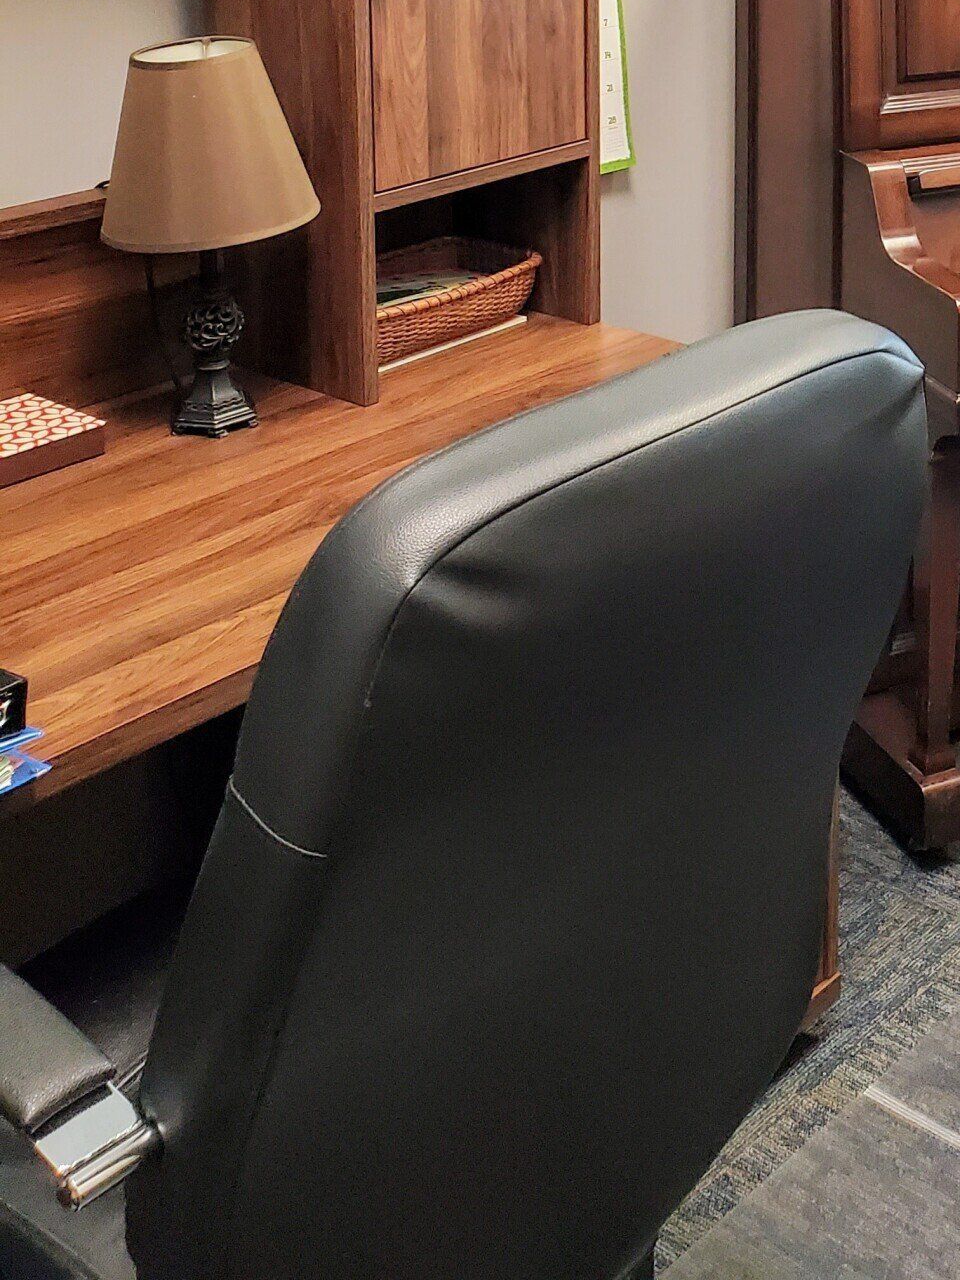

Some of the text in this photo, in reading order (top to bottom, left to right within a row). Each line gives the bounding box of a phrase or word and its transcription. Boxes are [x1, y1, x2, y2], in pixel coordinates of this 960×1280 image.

[603, 18, 608, 26] 7
[604, 51, 612, 59] 14
[606, 84, 613, 92] 21
